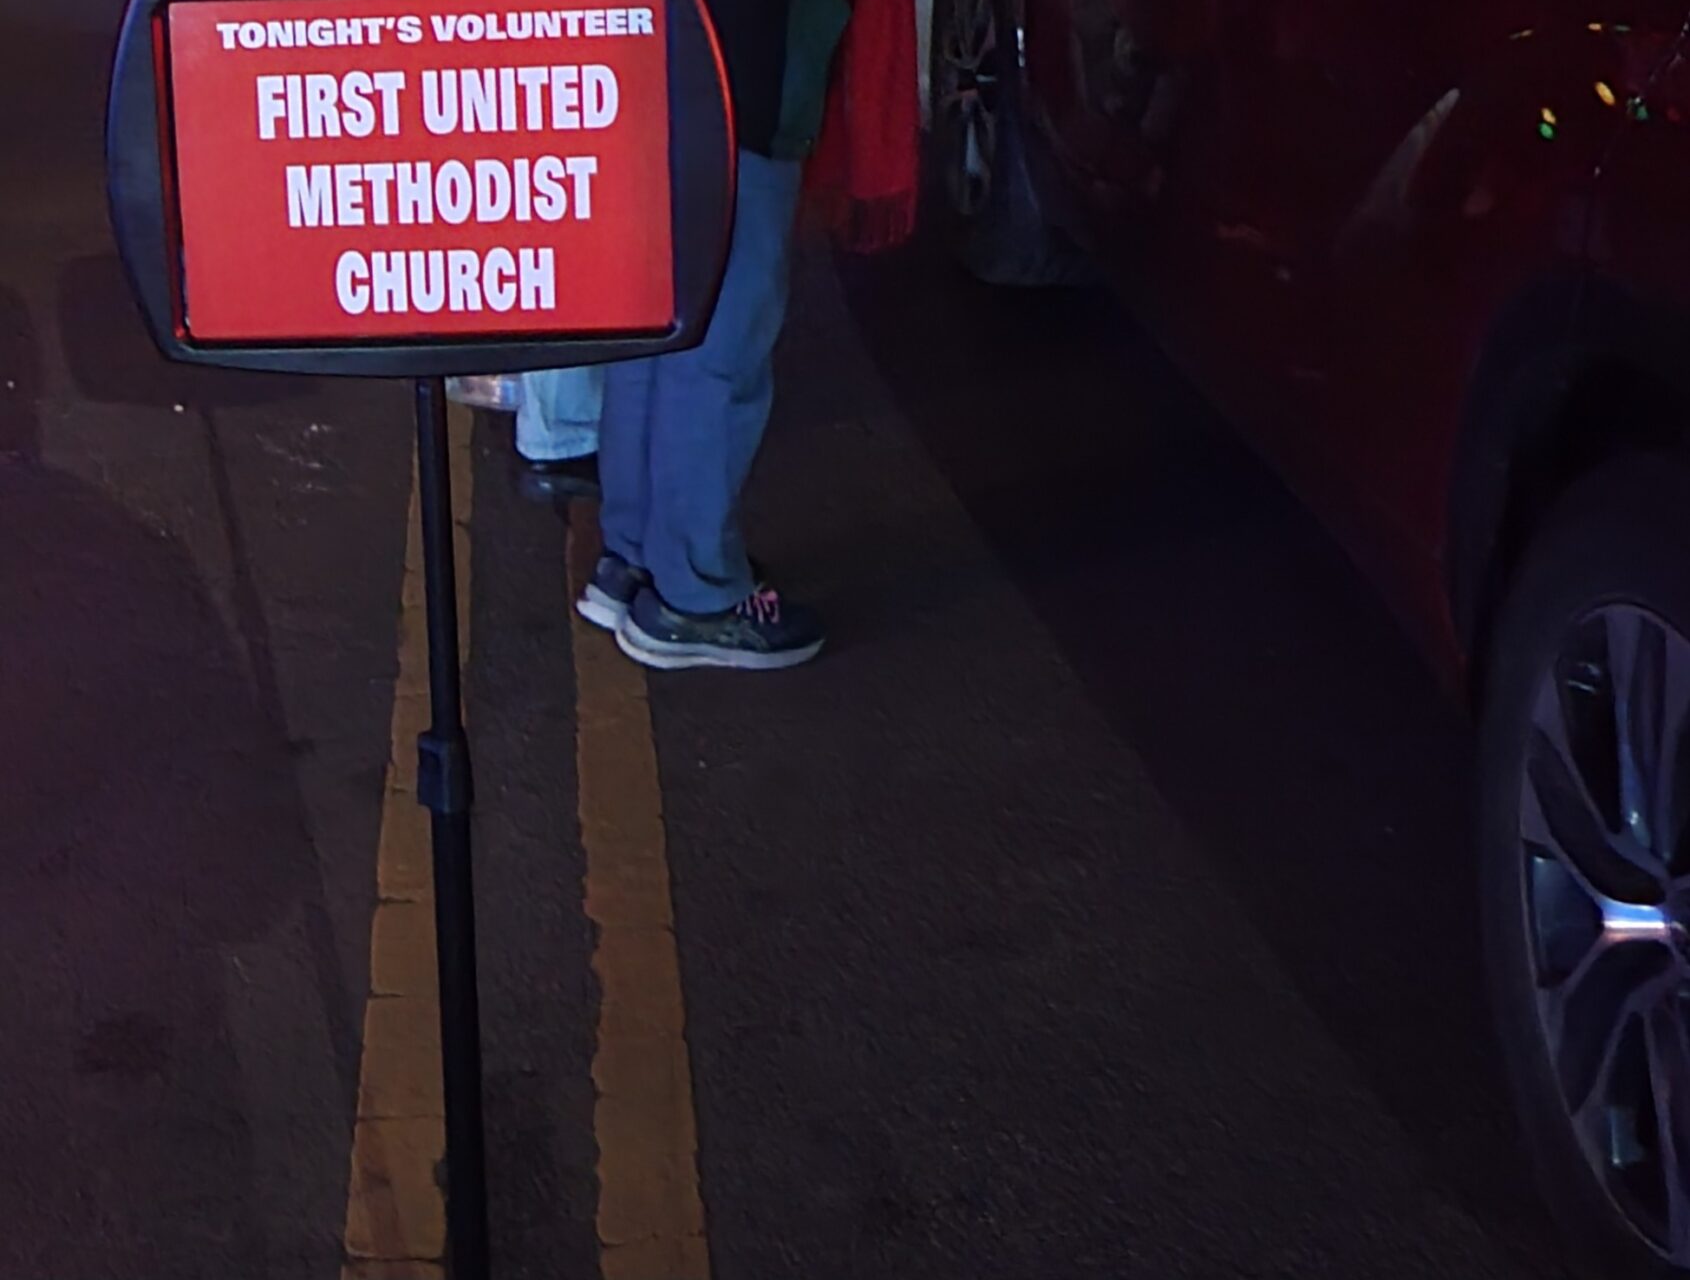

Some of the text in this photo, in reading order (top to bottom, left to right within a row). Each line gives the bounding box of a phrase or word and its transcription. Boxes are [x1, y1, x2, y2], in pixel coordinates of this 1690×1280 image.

[216, 8, 654, 49] TONIGHT'S VOLUNTEER
[257, 64, 619, 140] FIRST UNITED
[286, 156, 597, 227] METHODIST
[335, 247, 556, 315] CHURCH
